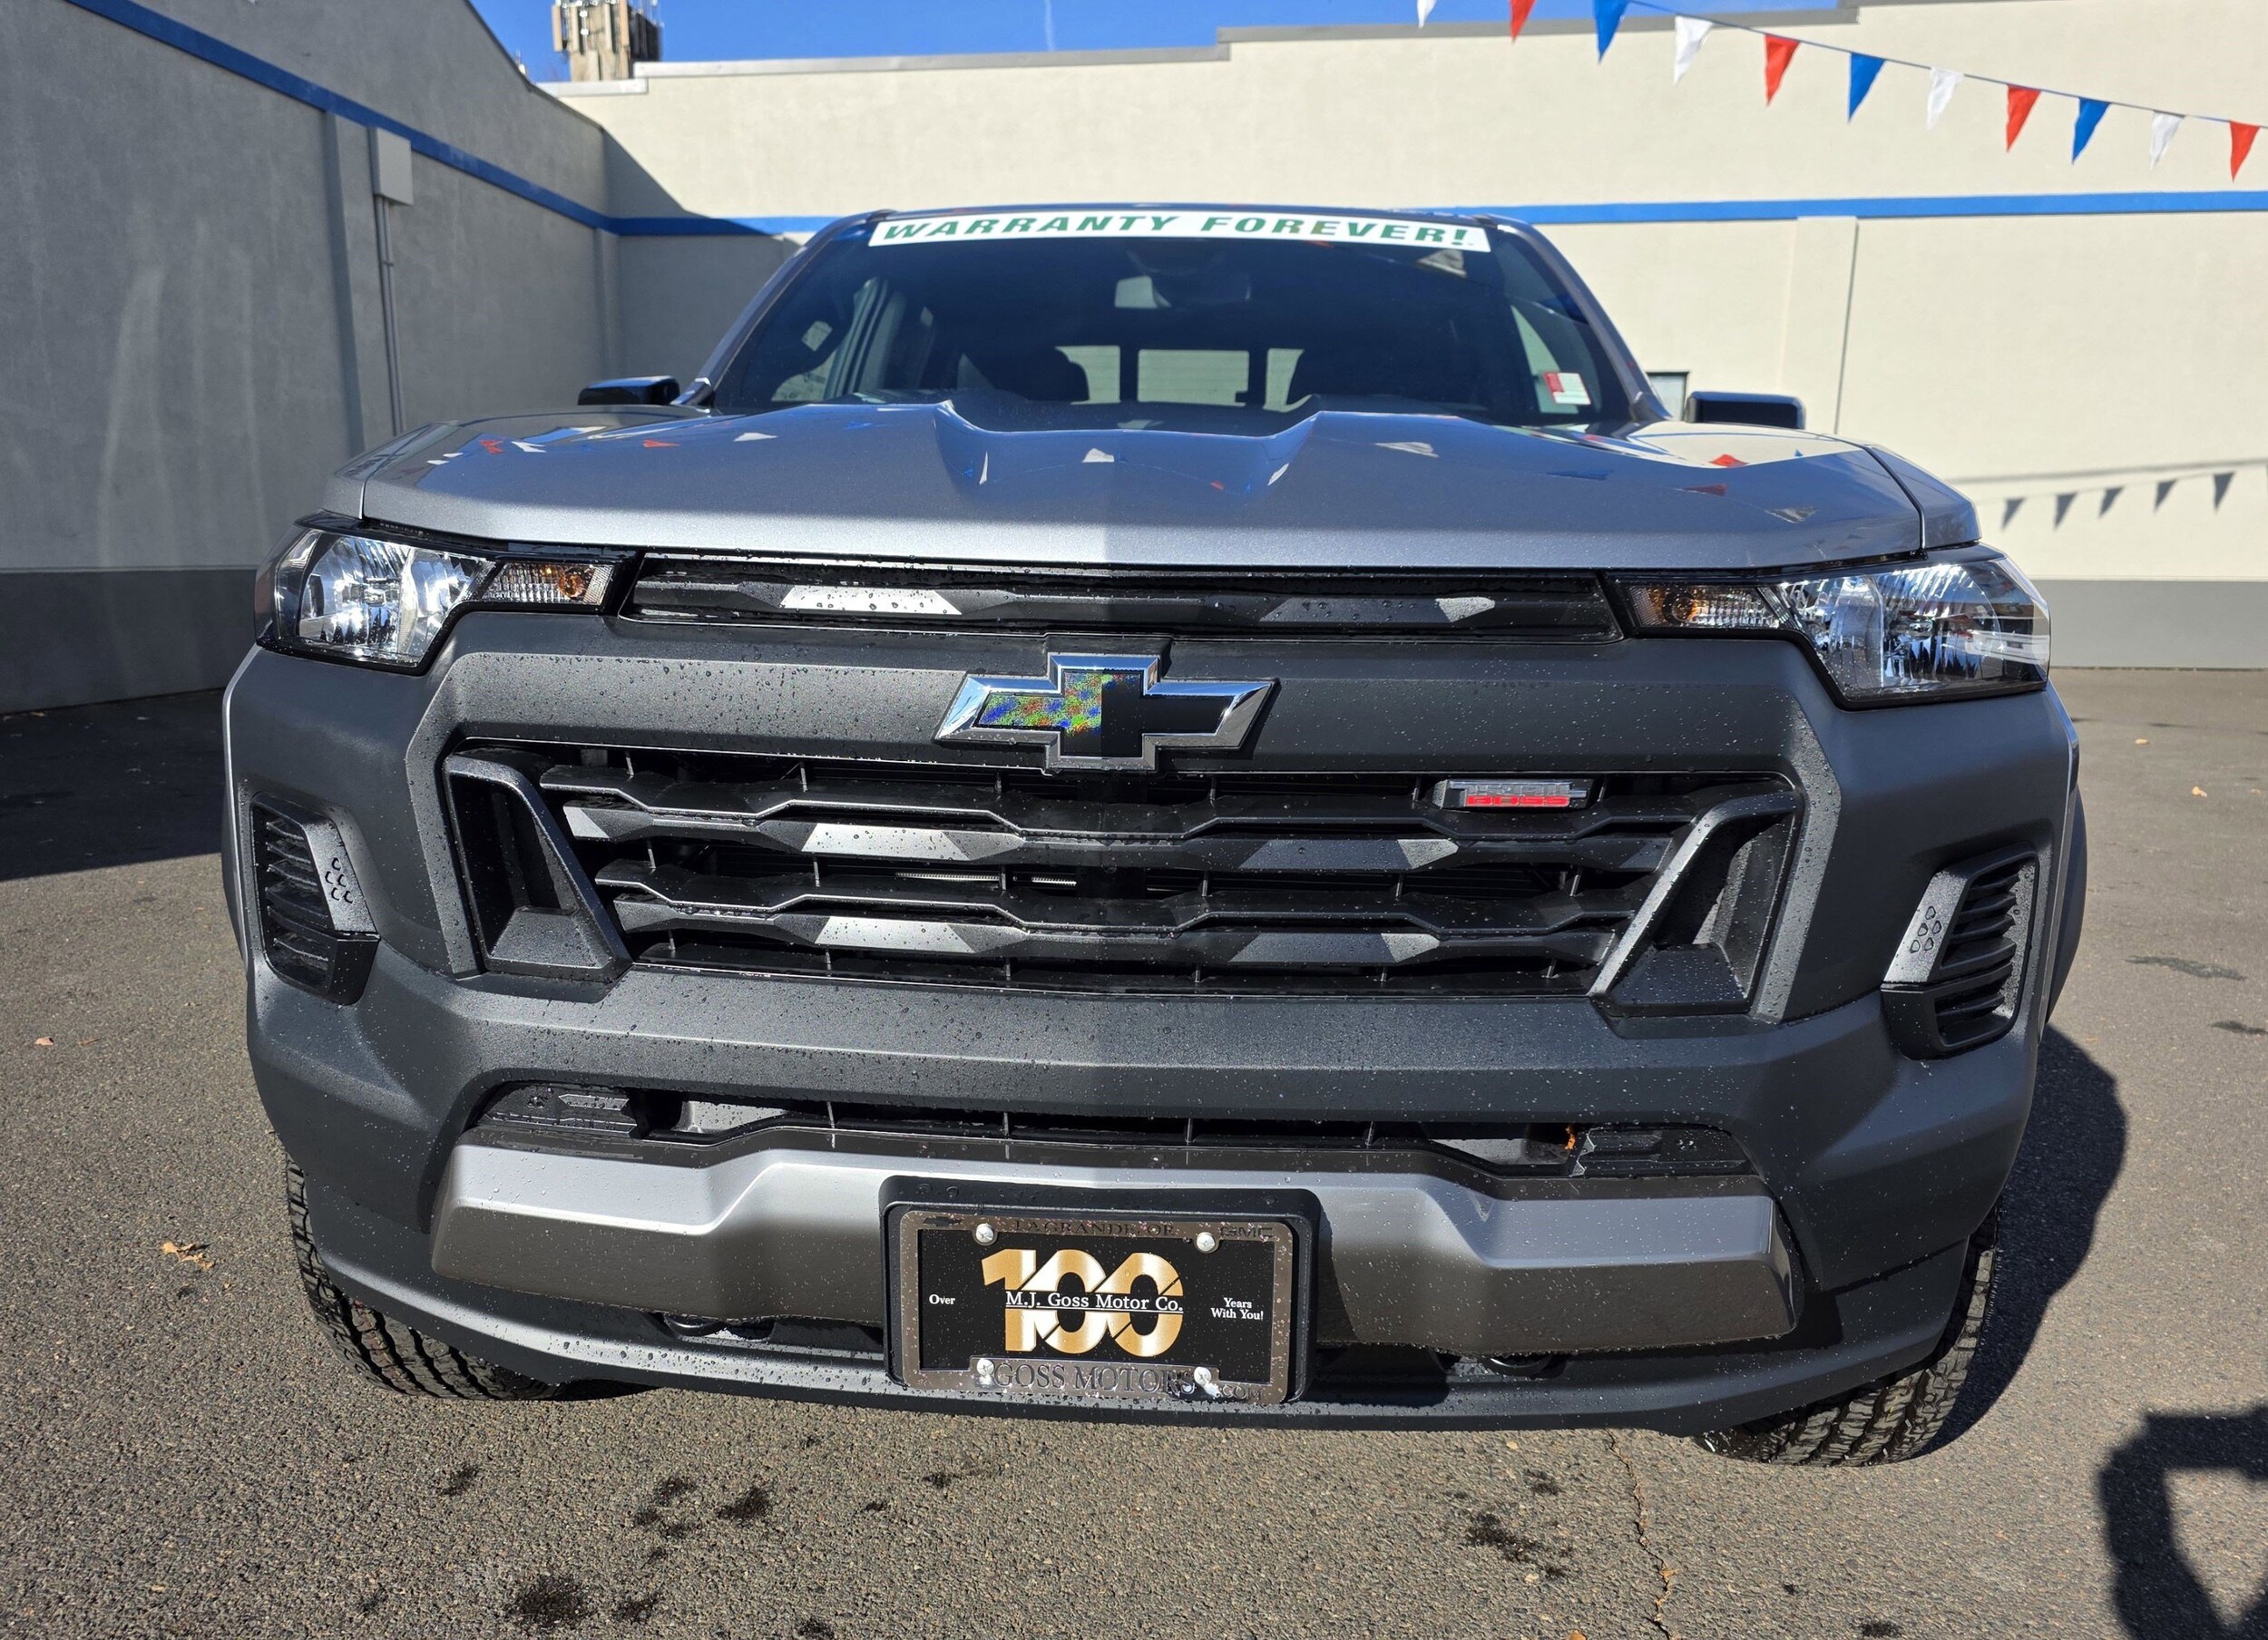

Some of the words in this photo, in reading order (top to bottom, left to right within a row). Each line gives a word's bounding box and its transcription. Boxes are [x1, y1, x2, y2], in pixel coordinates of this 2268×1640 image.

[883, 216, 1180, 239] WARRANTY
[1200, 217, 1468, 246] FOREVER!
[1465, 795, 1569, 807] BOSS
[1147, 1223, 1177, 1237] OR
[1220, 1225, 1274, 1238] GMC
[929, 1293, 956, 1304] Over
[982, 1249, 1183, 1357] 100
[1005, 1292, 1041, 1306] M.J.
[1048, 1293, 1089, 1307] Goss
[1095, 1294, 1149, 1309] Motor
[1155, 1297, 1183, 1312] Co.
[1223, 1297, 1252, 1309] Years
[1210, 1307, 1237, 1319] With
[1239, 1309, 1264, 1322] You!
[994, 1363, 1065, 1390] GOSS
[1073, 1365, 1196, 1395] MOTORS
